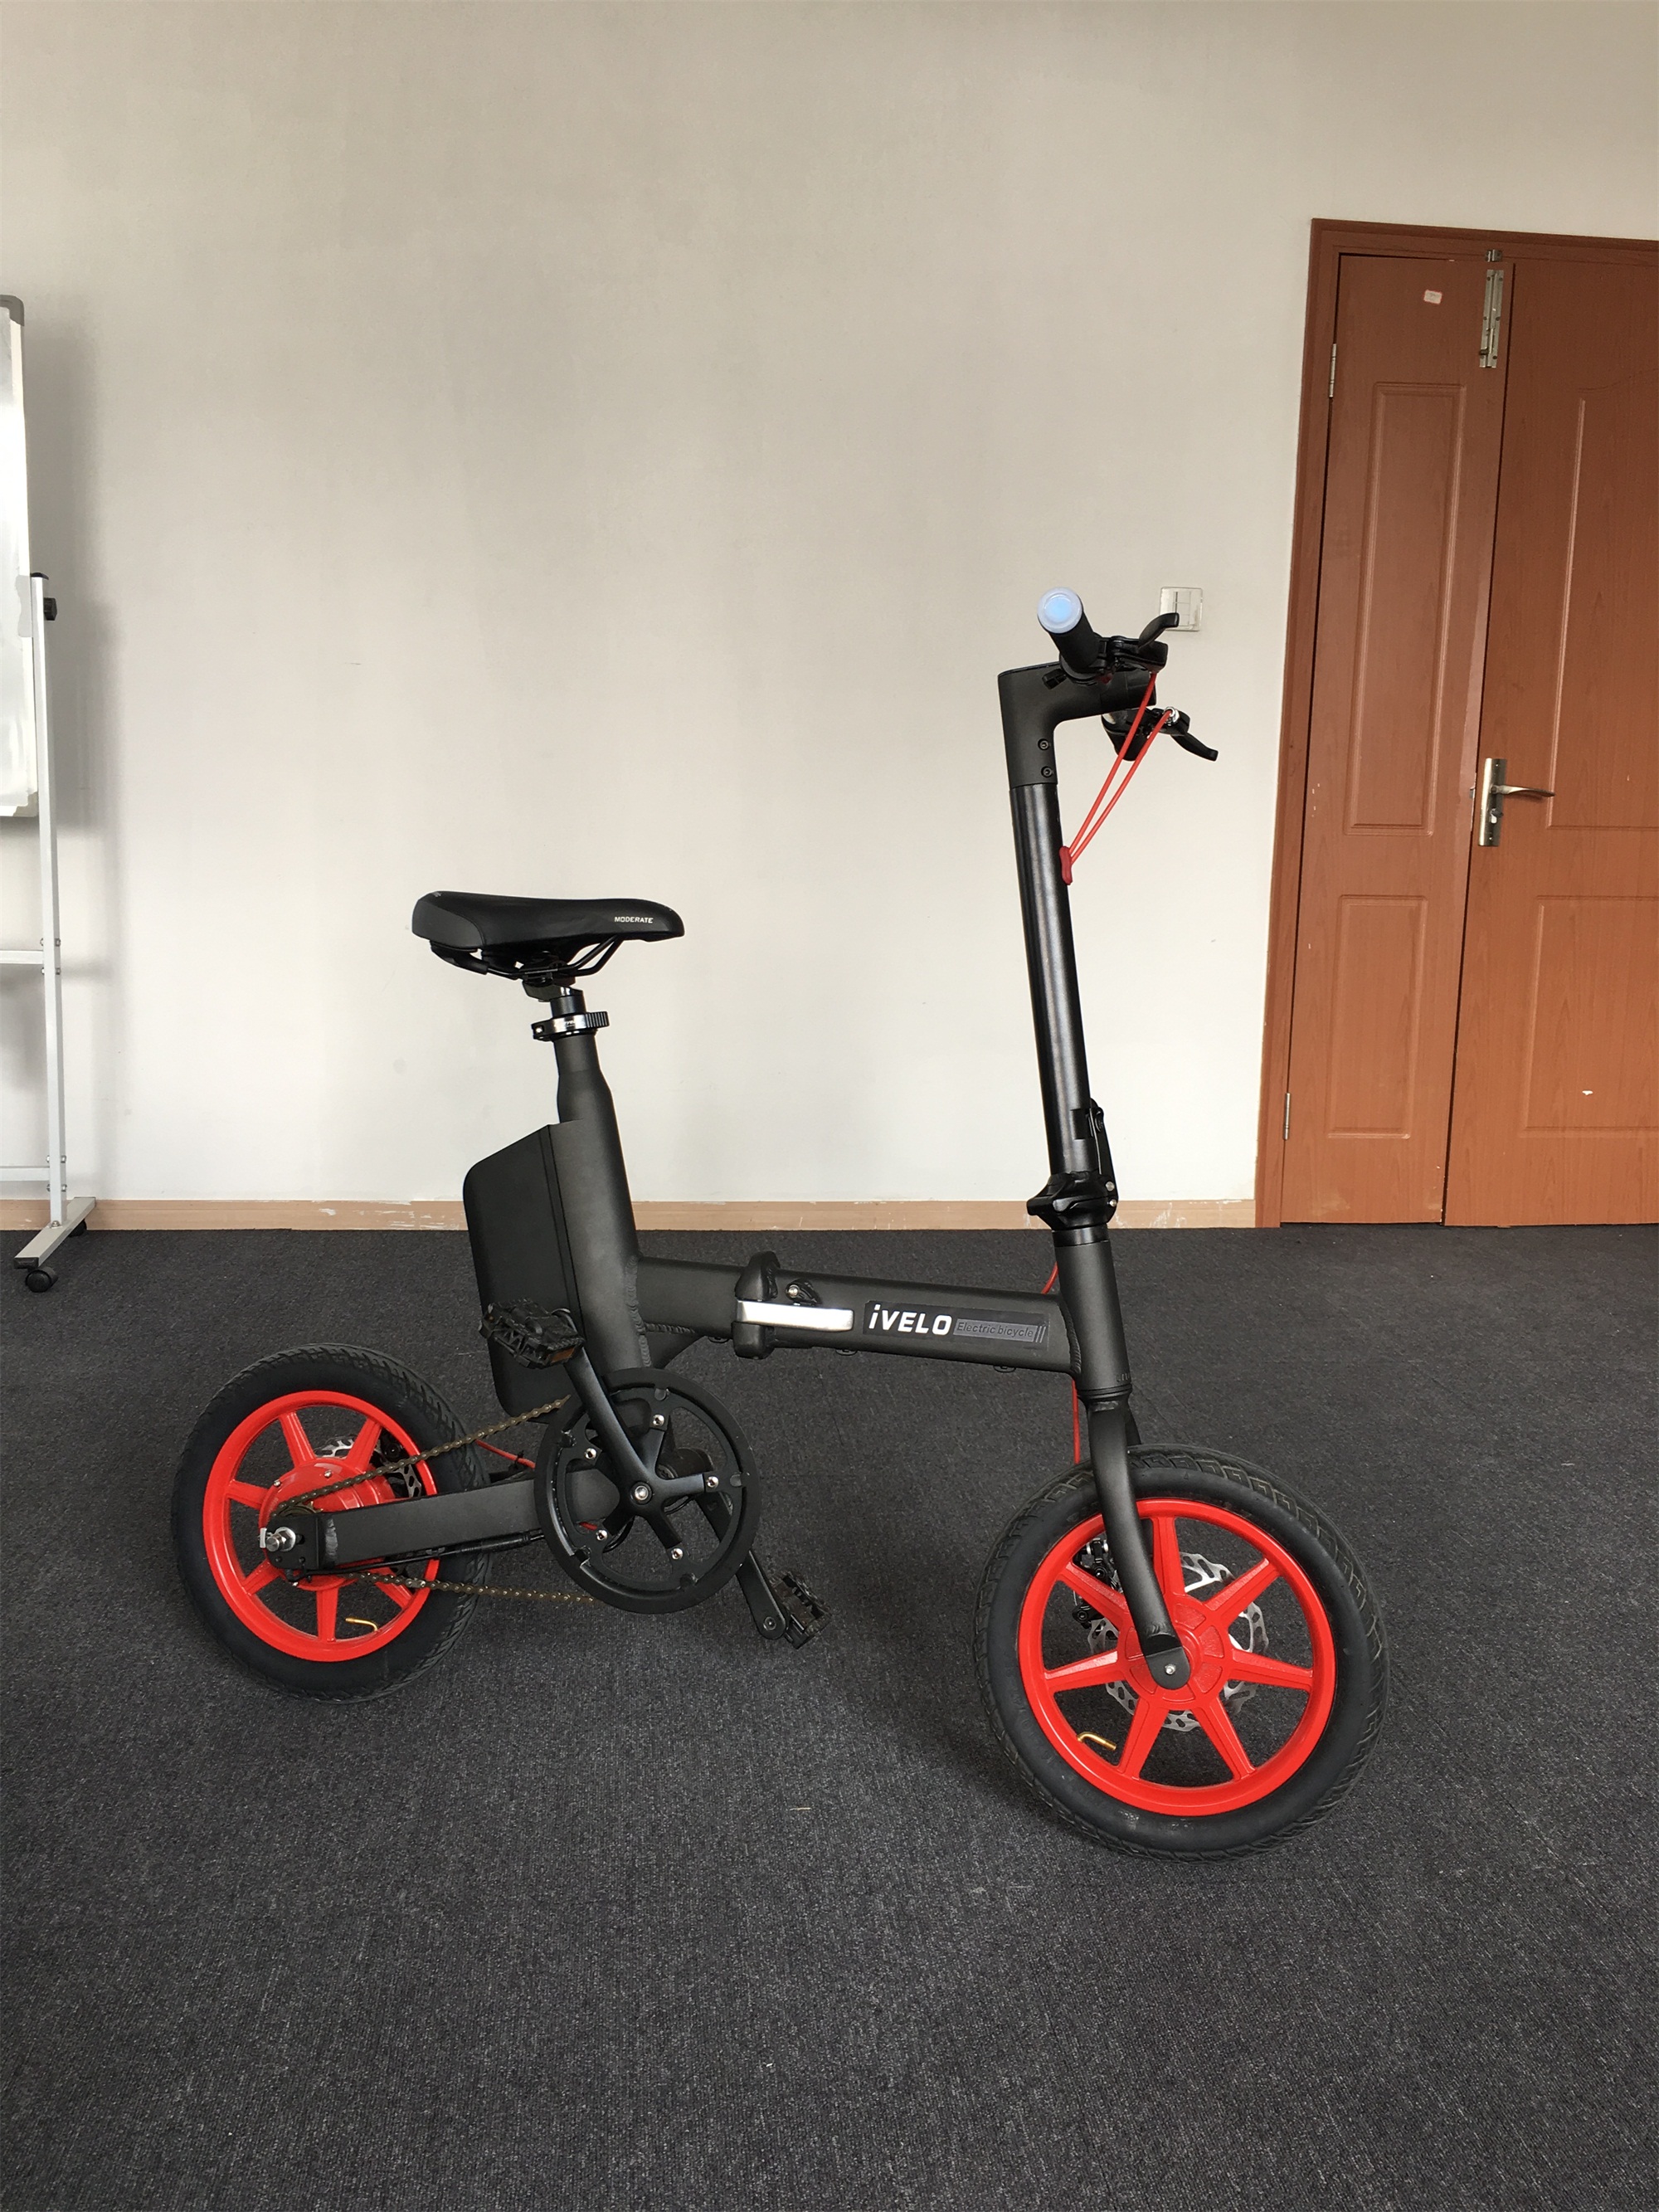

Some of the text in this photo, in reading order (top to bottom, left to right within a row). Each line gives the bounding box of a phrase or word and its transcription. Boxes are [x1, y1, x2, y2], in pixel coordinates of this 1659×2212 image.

[868, 1303, 952, 1336] iVELO
[956, 1322, 1034, 1338] Electric bicycle
